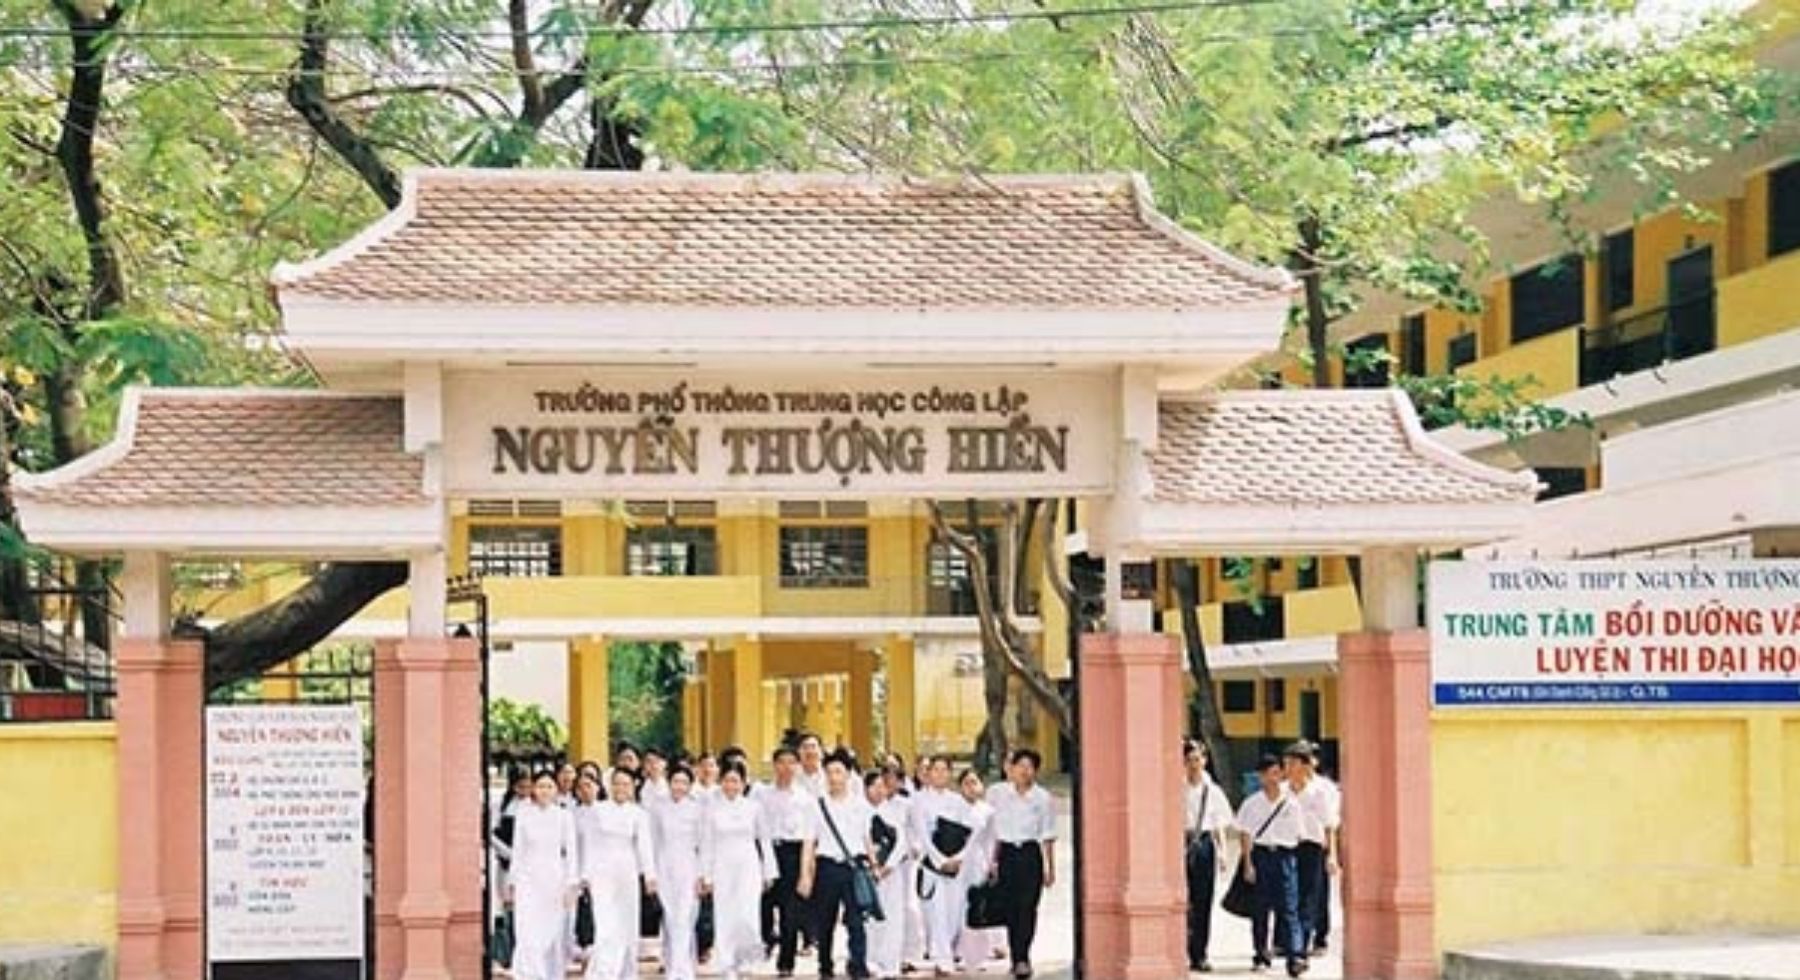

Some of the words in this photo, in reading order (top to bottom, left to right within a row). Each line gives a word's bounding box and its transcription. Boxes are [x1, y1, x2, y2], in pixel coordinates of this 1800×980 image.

[534, 382, 631, 412] TRƯỜNG
[638, 381, 687, 413] PHỔ
[691, 386, 770, 412] THÔNG
[773, 391, 852, 412] TRUNG
[857, 391, 906, 419] HỌC
[911, 385, 977, 412] CÔNG
[982, 385, 1029, 417] LẬP
[492, 415, 699, 474] NGUYỄN
[721, 417, 927, 487] THƯỢNG
[946, 413, 1069, 474] HIỀN
[1489, 567, 1568, 590] TRƯỜNG
[1577, 572, 1626, 590] THPT
[1444, 613, 1528, 637] TRUNG
[1537, 608, 1595, 637] TÂM
[1663, 599, 1763, 636] DƯỠNG
[1537, 638, 1630, 679] LUYỆN
[1641, 647, 1688, 672] THI
[1698, 647, 1747, 677] ĐẠI
[1758, 647, 1800, 677] HỌ
